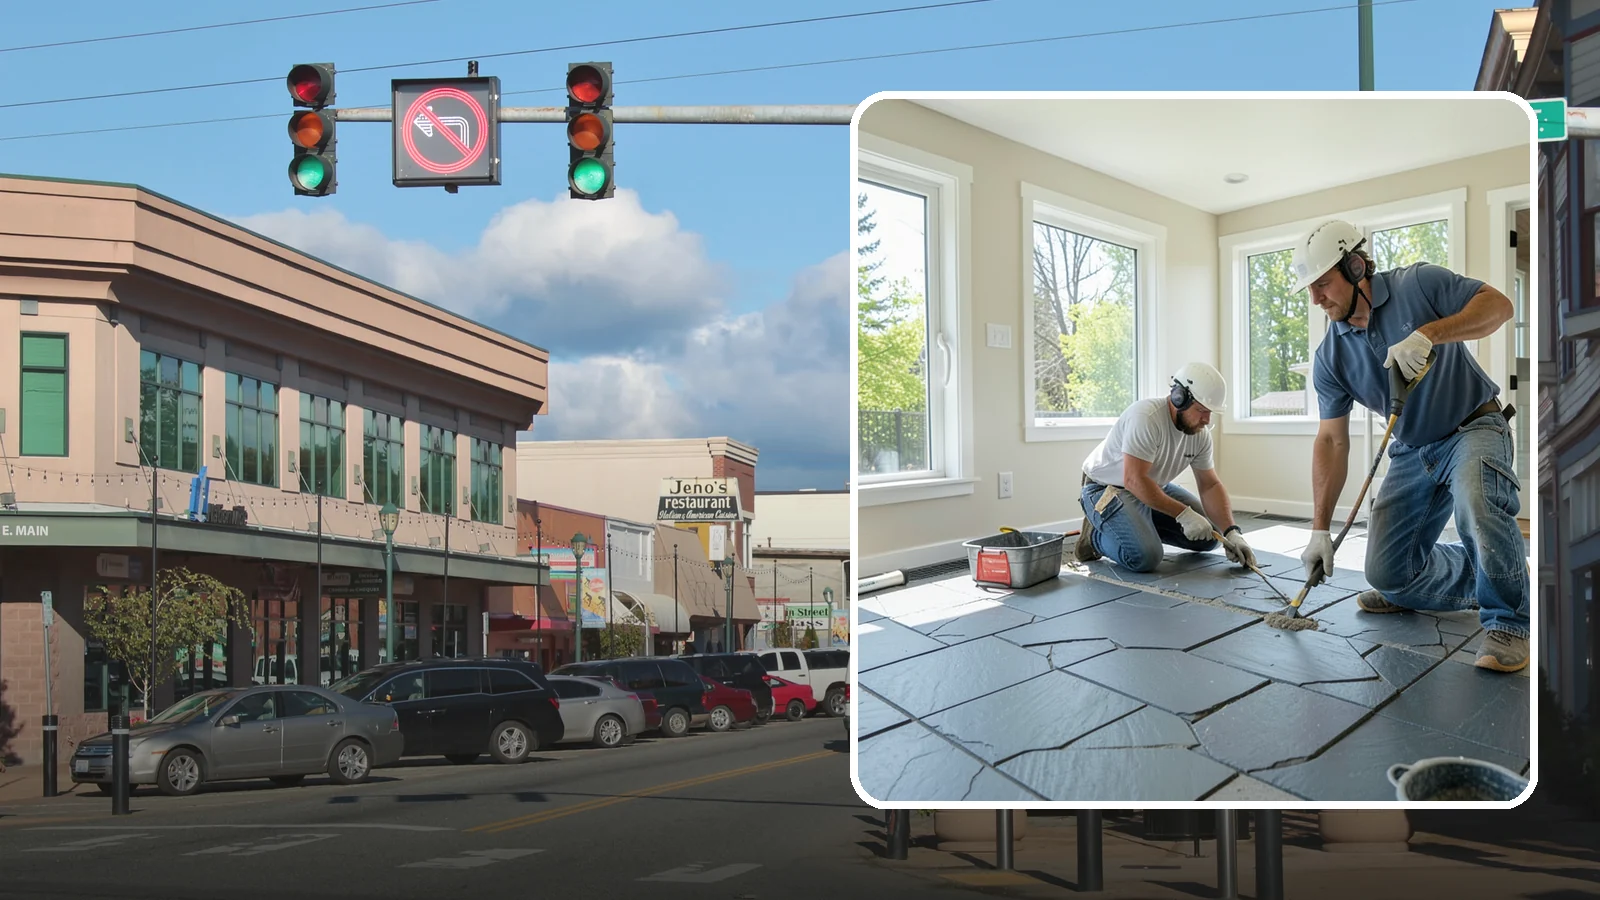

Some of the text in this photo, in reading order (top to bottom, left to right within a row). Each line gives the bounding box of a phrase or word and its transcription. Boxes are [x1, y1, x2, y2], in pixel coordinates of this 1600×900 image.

[669, 479, 728, 494] Jeno's
[665, 496, 731, 509] restaurant
[2, 525, 49, 536] E. MAIN
[797, 607, 828, 616] Street
